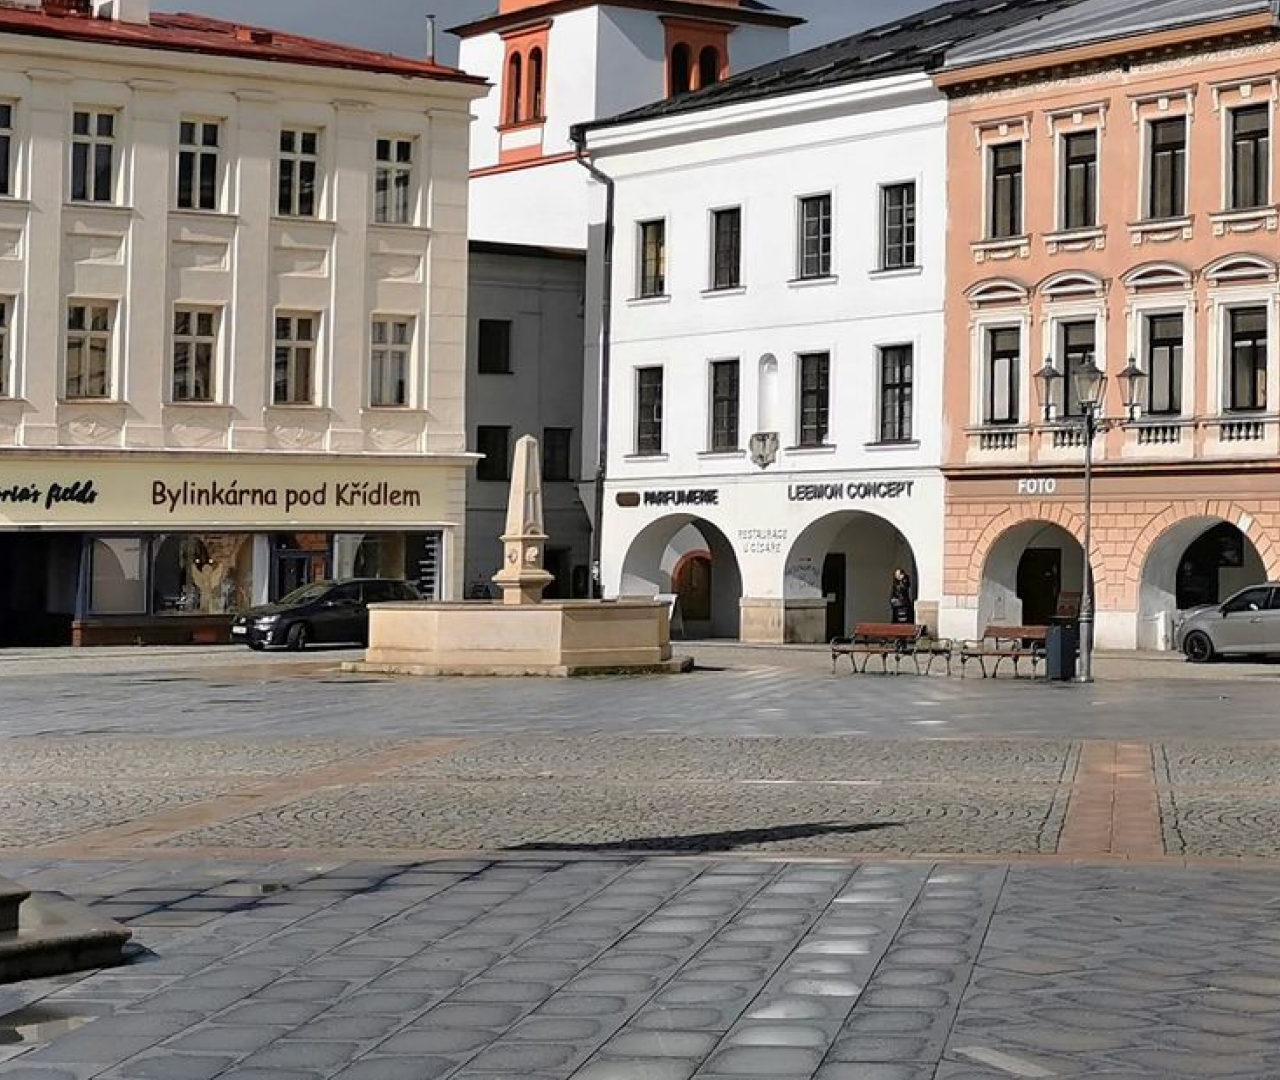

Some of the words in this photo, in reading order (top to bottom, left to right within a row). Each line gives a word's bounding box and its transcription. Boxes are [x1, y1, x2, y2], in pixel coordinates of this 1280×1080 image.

[846, 481, 914, 499] CONCEPT
[1018, 478, 1056, 494] FOTO
[152, 480, 278, 513] Bylinkárna
[285, 482, 326, 513] pod
[335, 481, 420, 507] Křídlem
